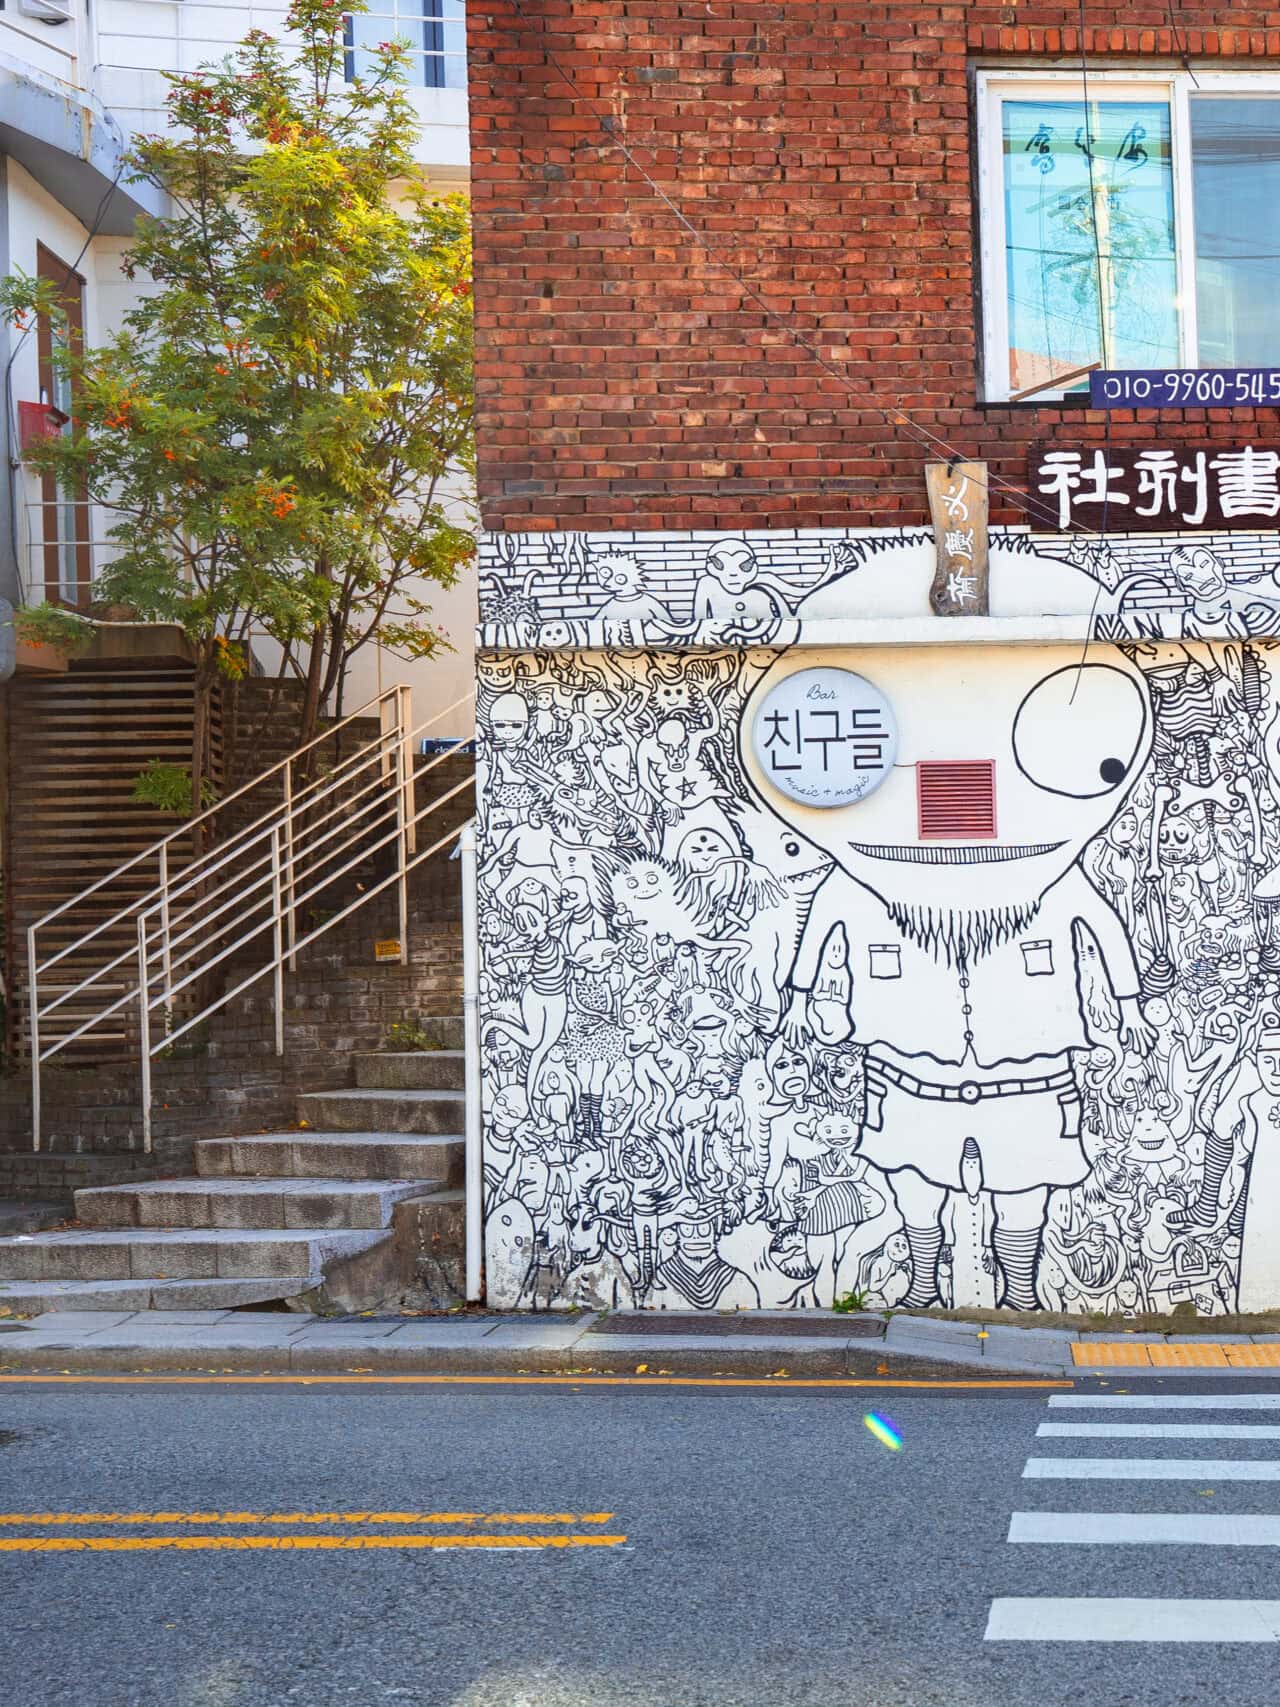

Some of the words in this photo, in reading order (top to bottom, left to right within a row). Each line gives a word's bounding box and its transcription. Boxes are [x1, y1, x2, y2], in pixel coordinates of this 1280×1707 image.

[806, 683, 838, 701] Bar
[763, 708, 890, 772] 친구들
[784, 777, 820, 797] music
[834, 775, 871, 797] magic
